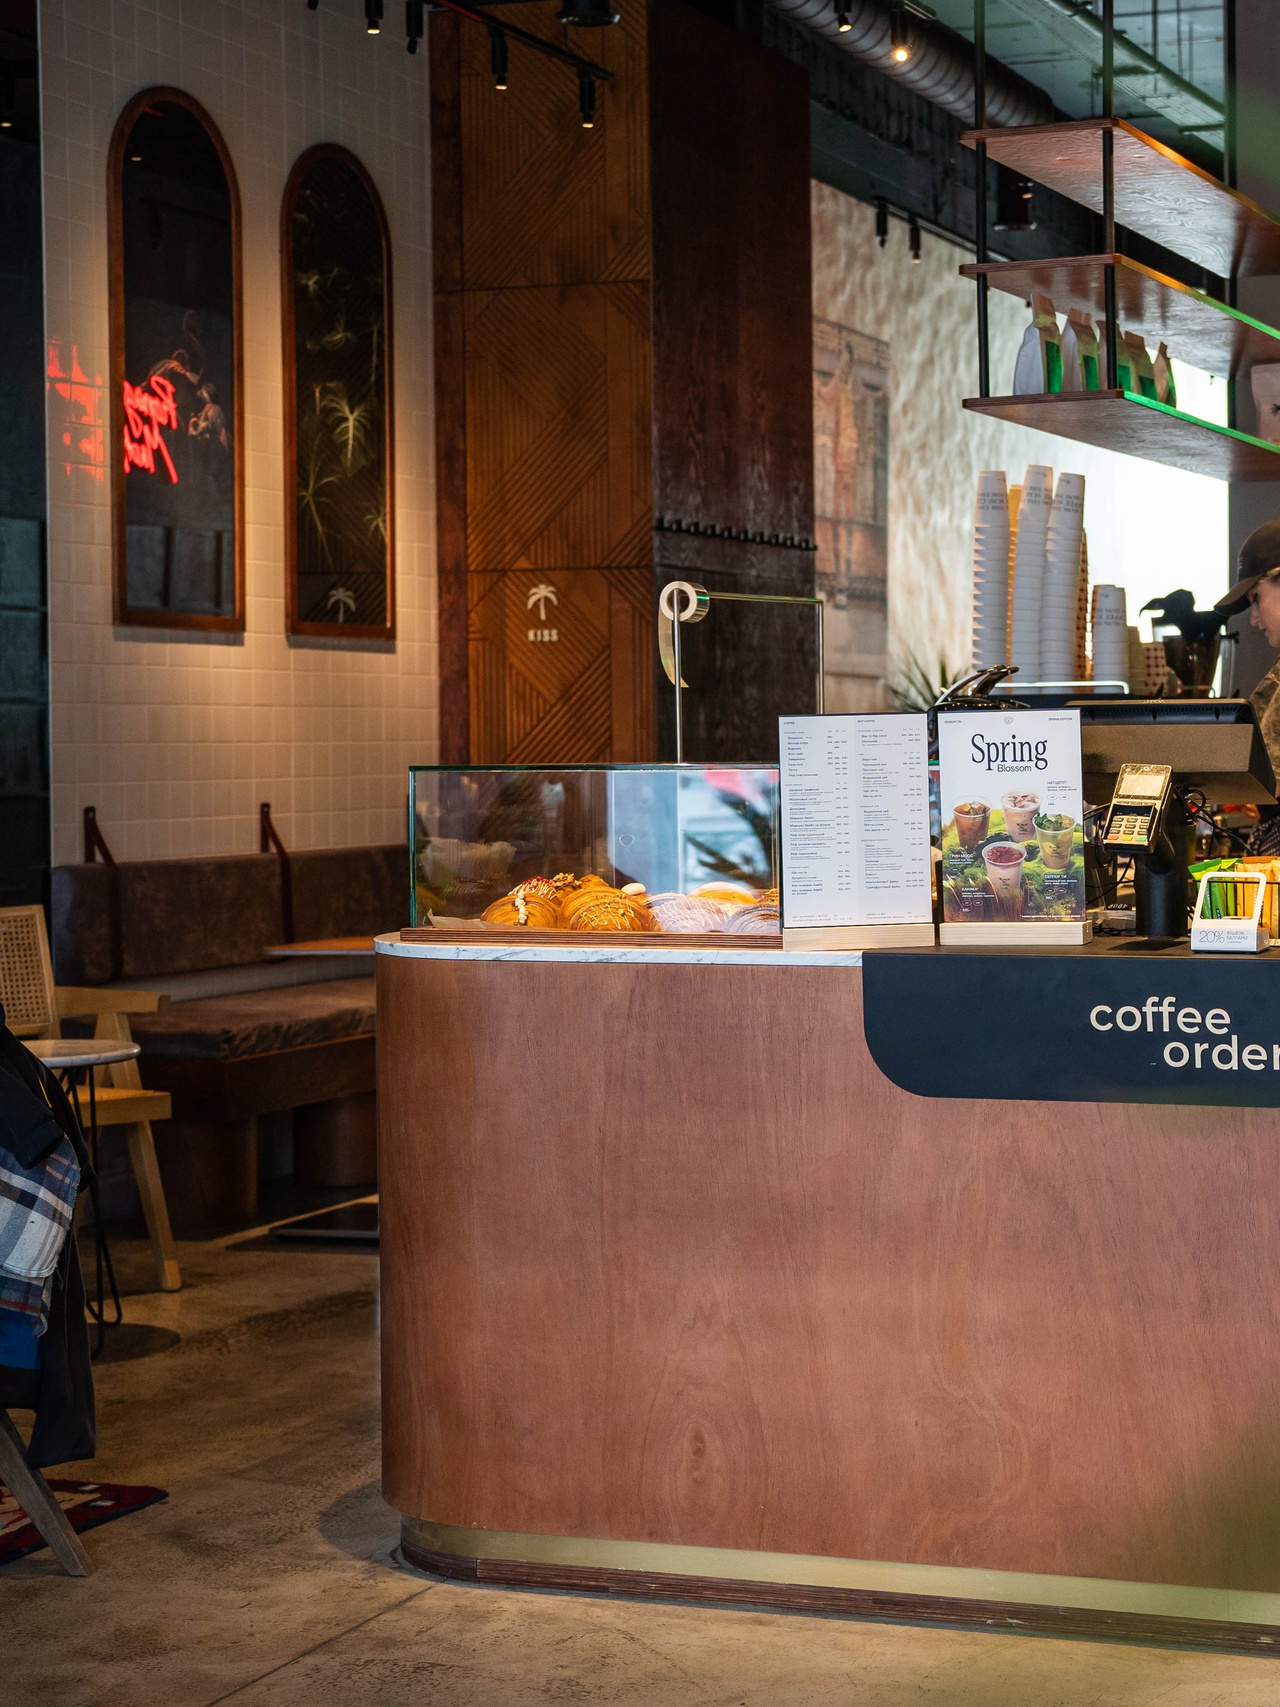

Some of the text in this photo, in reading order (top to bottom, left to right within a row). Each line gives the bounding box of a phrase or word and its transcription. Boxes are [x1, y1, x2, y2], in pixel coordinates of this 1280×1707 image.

[527, 628, 559, 642] KISS
[971, 733, 1048, 771] Spring
[997, 763, 1032, 773] Blossom
[1199, 930, 1226, 943] 20%
[1090, 996, 1231, 1034] coffee
